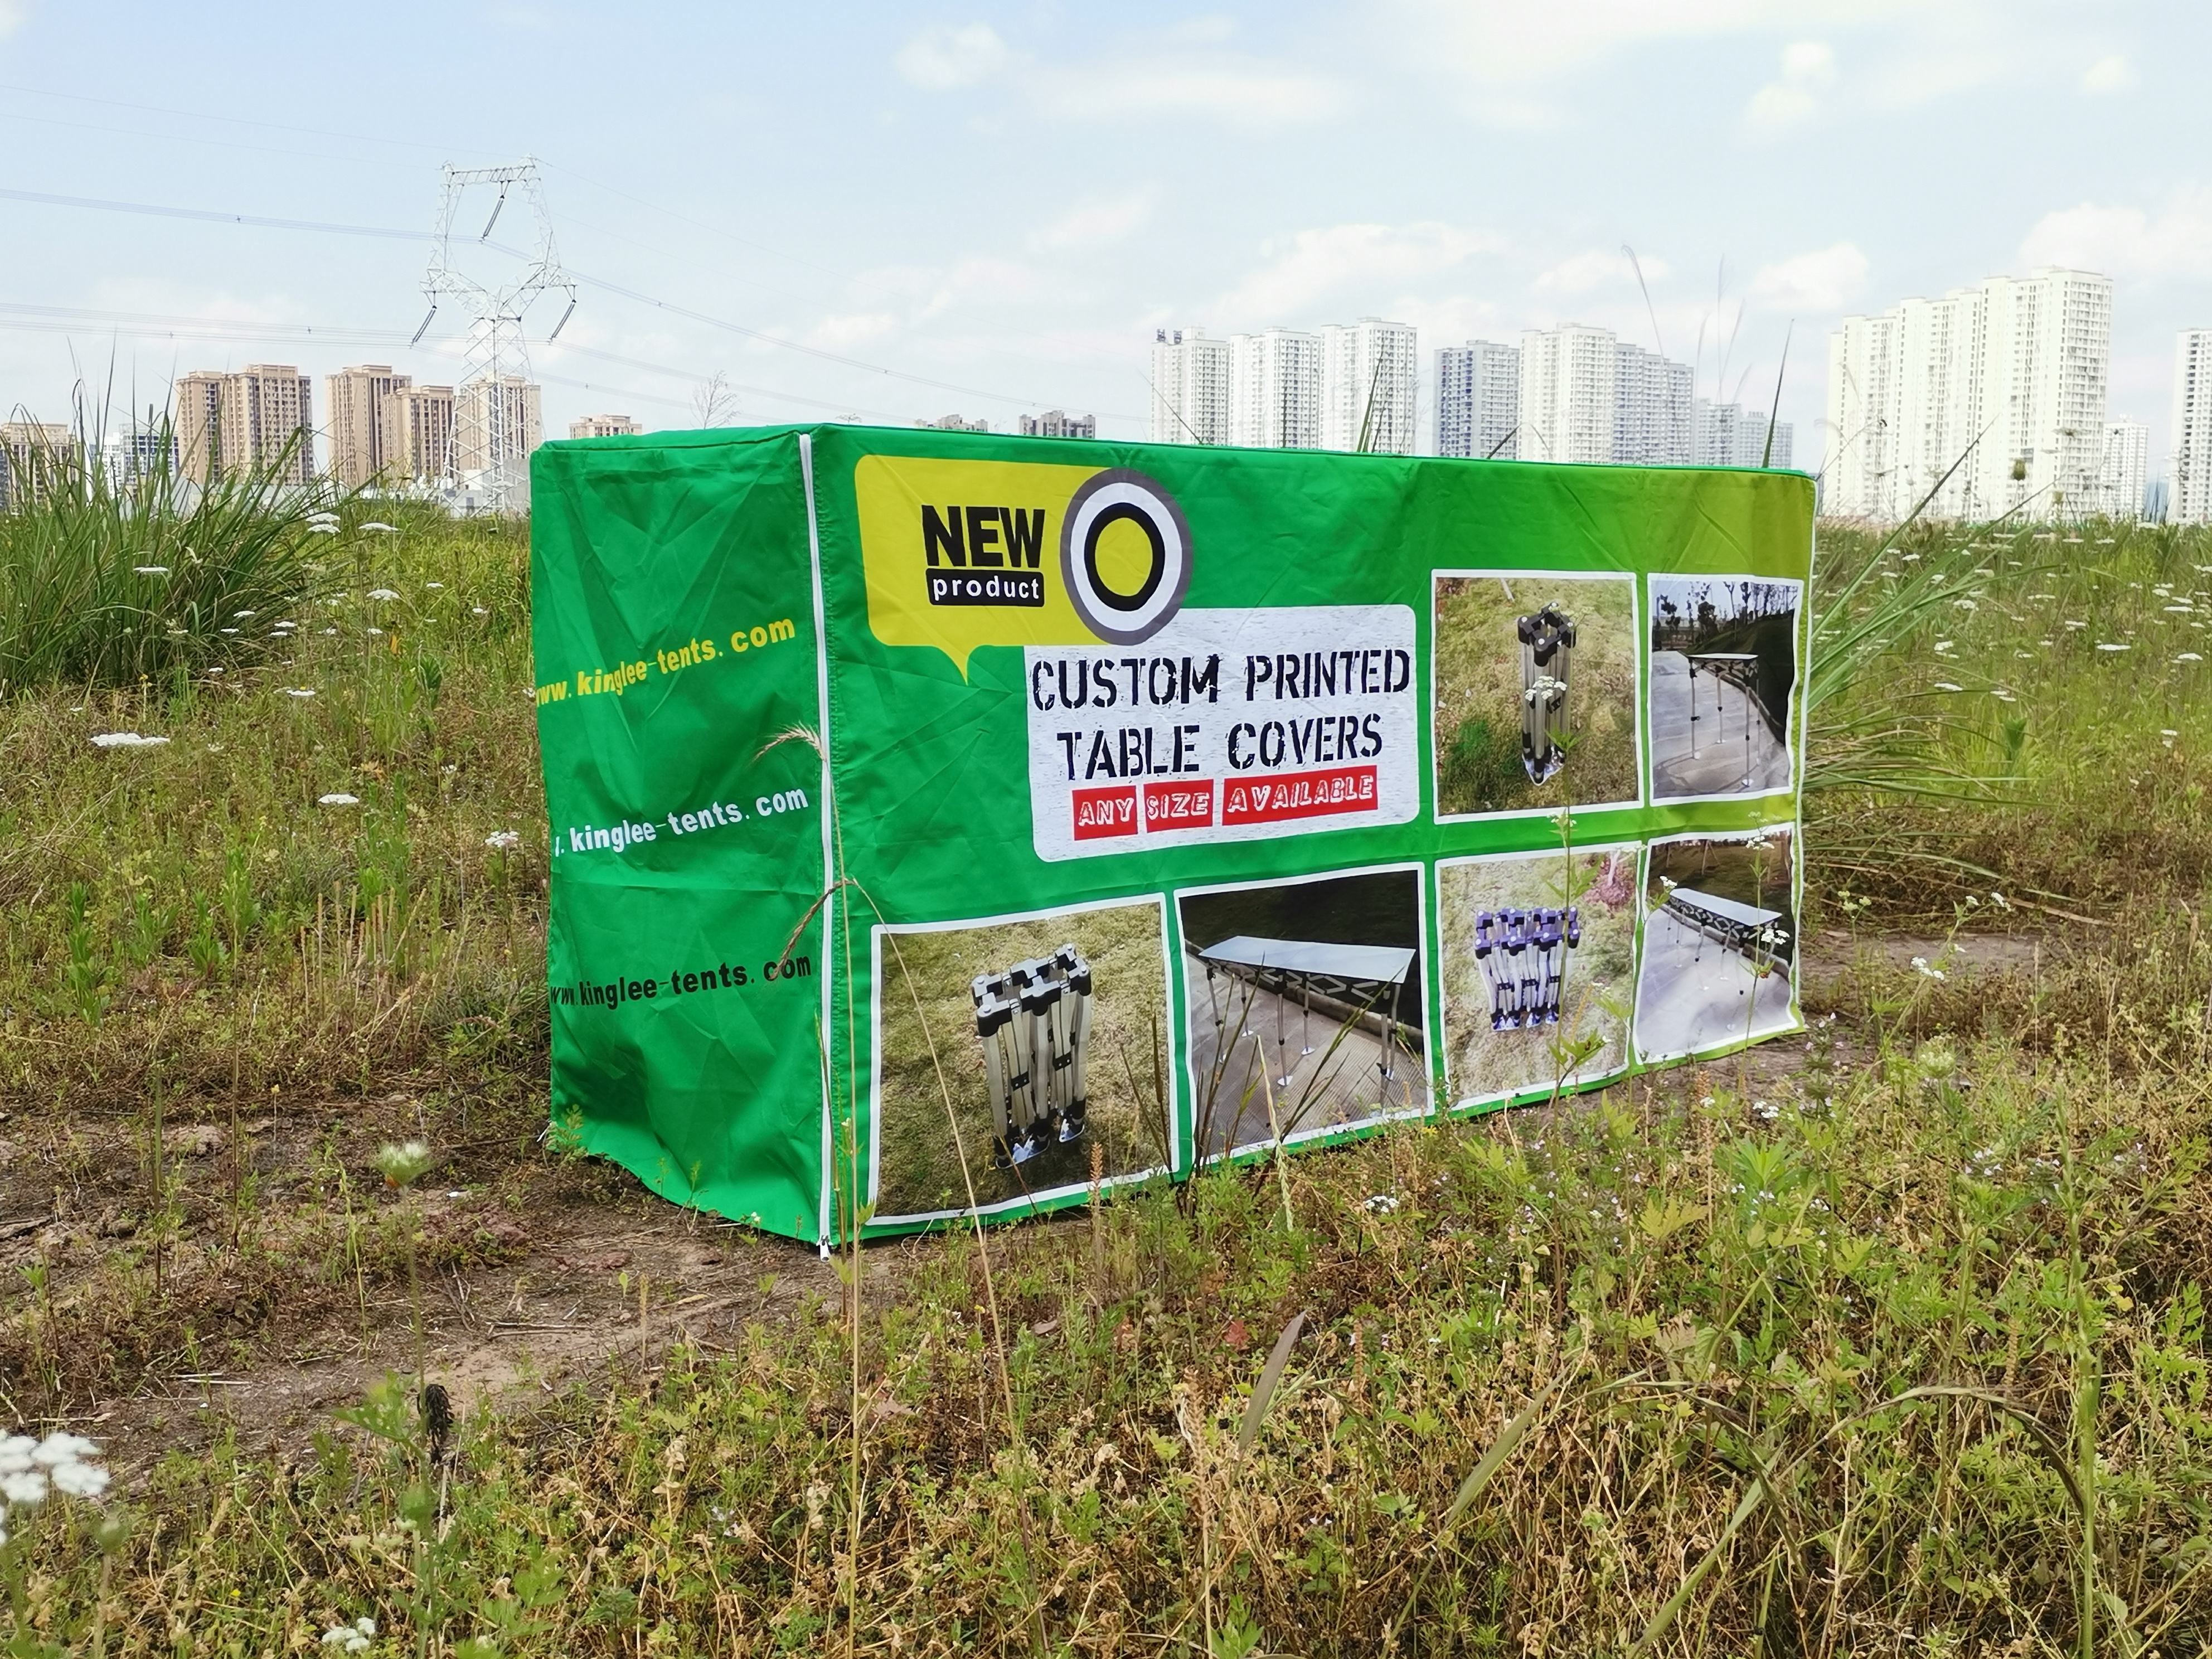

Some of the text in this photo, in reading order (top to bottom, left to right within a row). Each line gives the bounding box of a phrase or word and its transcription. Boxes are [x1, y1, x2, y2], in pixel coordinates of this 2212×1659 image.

[921, 505, 1045, 569] NEW
[932, 575, 1040, 601] product
[1031, 649, 1410, 711] CUSTOM PRINTED
[1056, 713, 1382, 780] TABLE COVERS
[1078, 774, 1374, 827] ANY SIZE AVAILABLE
